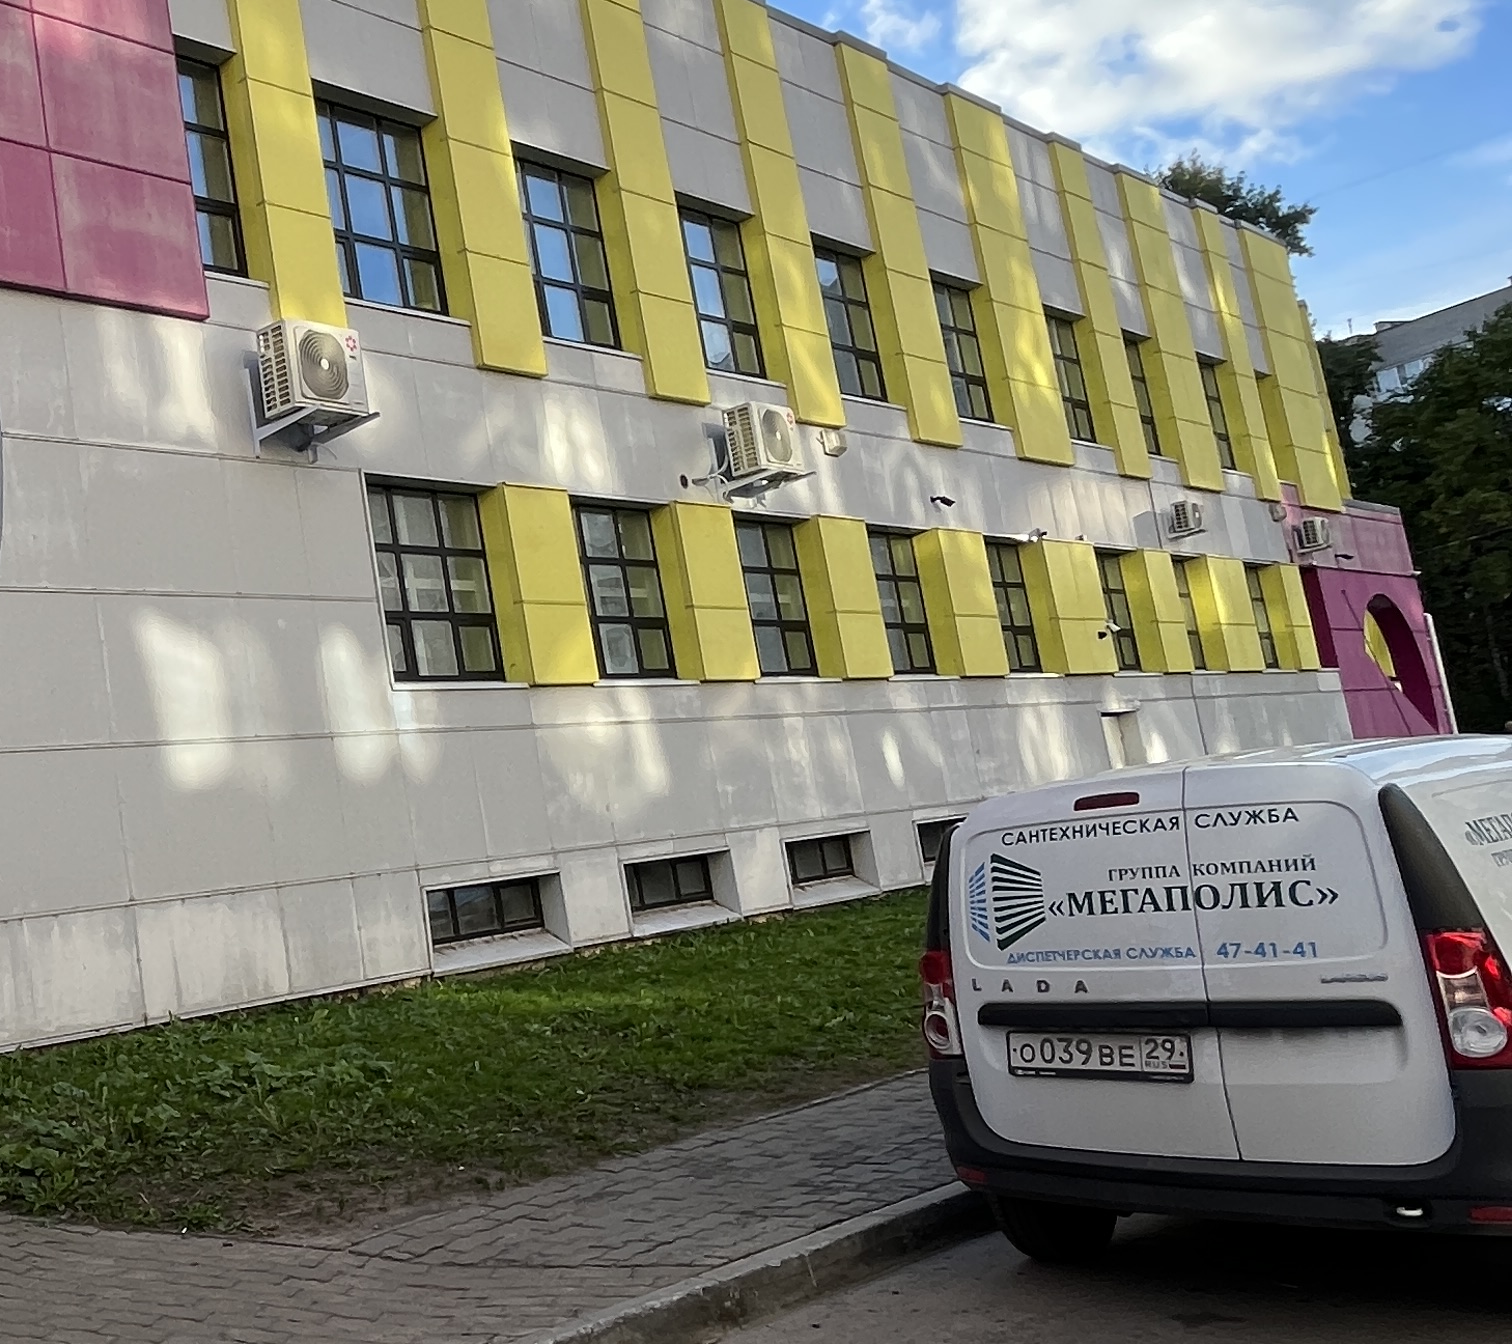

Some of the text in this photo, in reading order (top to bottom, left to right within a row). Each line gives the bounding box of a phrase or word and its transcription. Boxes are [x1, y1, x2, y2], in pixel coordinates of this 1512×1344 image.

[1001, 807, 1299, 846] САНТЕХНИЧЕСКАЯ СЛУЖБА
[1107, 853, 1317, 882] ГРУППА КОМПАНИЙ
[1048, 879, 1339, 917] «МЕГАПОЛИС»
[1006, 942, 1318, 964] ДИСПЕТЧЕРСКАЯ СЛУЖБА 47-41-41
[971, 978, 1088, 994] LADA
[1144, 1038, 1176, 1061] 29
